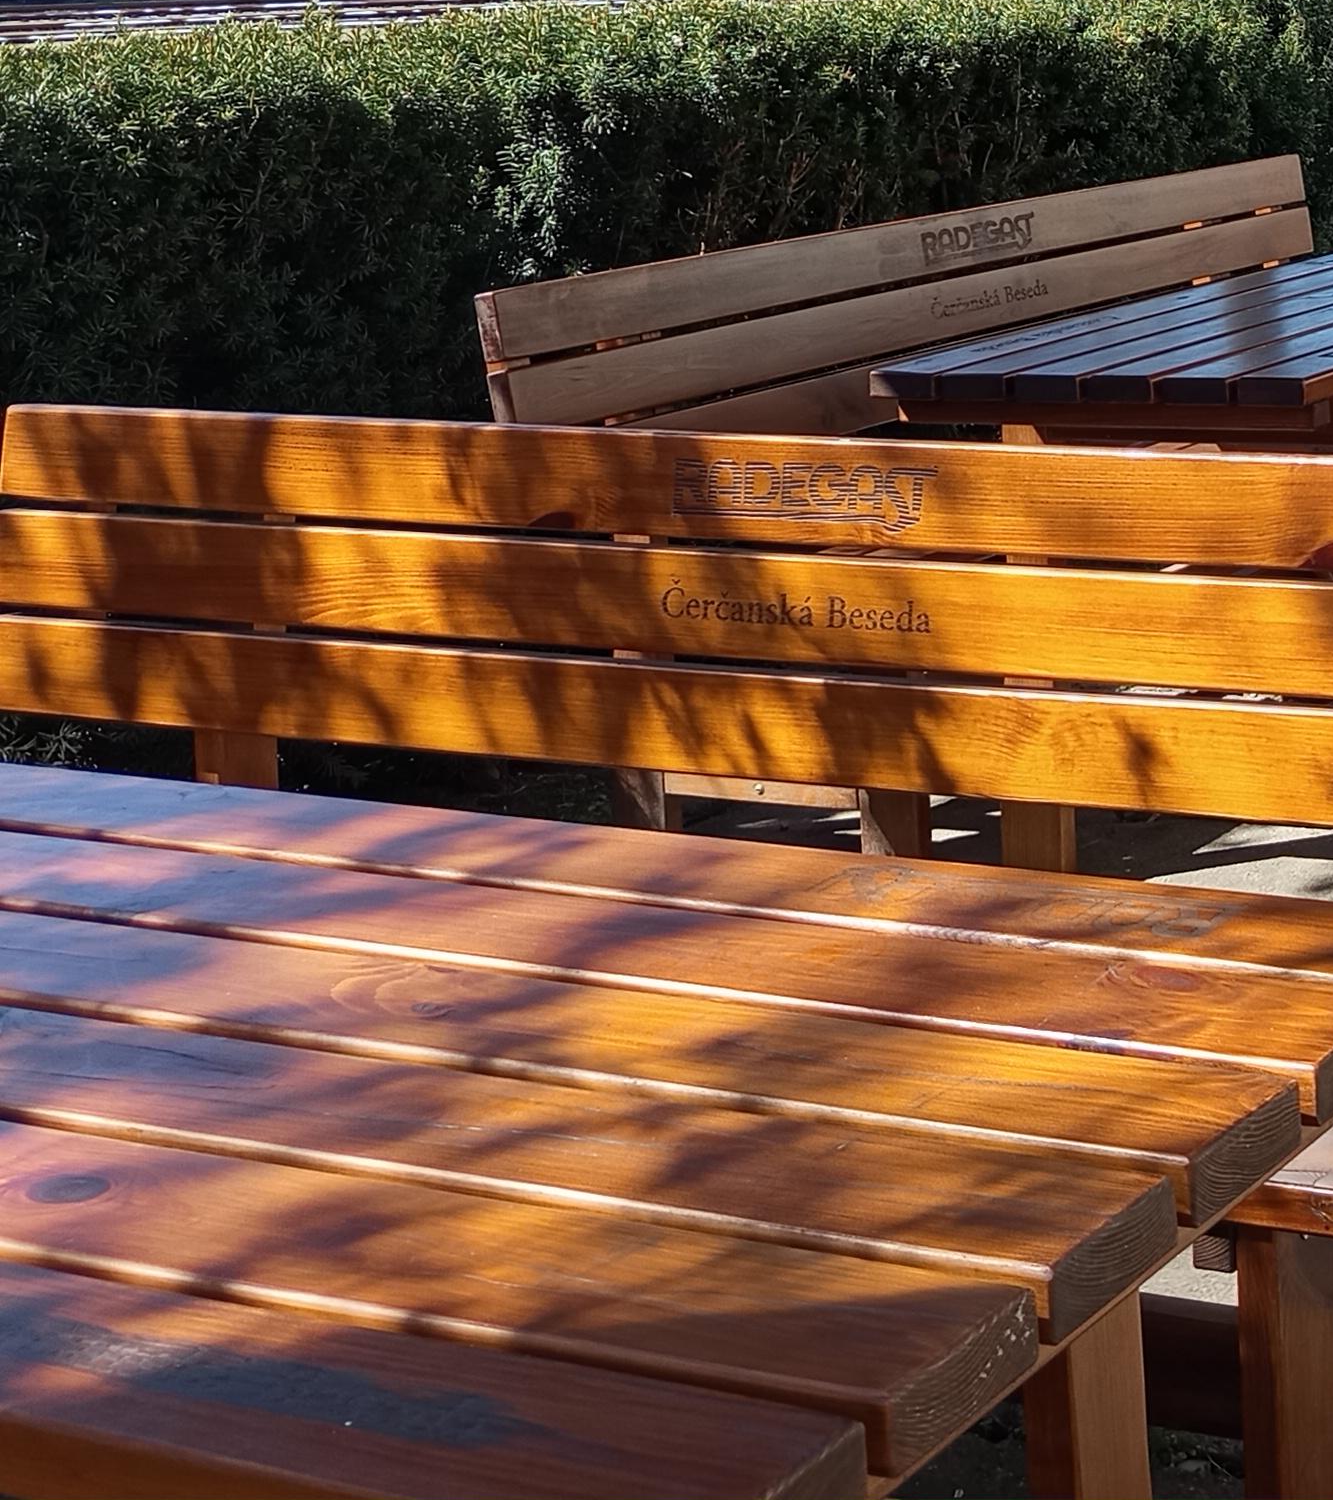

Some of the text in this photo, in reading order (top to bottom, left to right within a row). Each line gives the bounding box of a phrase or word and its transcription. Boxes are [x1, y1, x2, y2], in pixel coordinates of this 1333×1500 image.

[921, 211, 1036, 267] RADEGAST
[1005, 279, 1049, 304] Beseda
[672, 458, 939, 534] RADEGAST
[661, 578, 931, 634] Čerčanská Beseda
